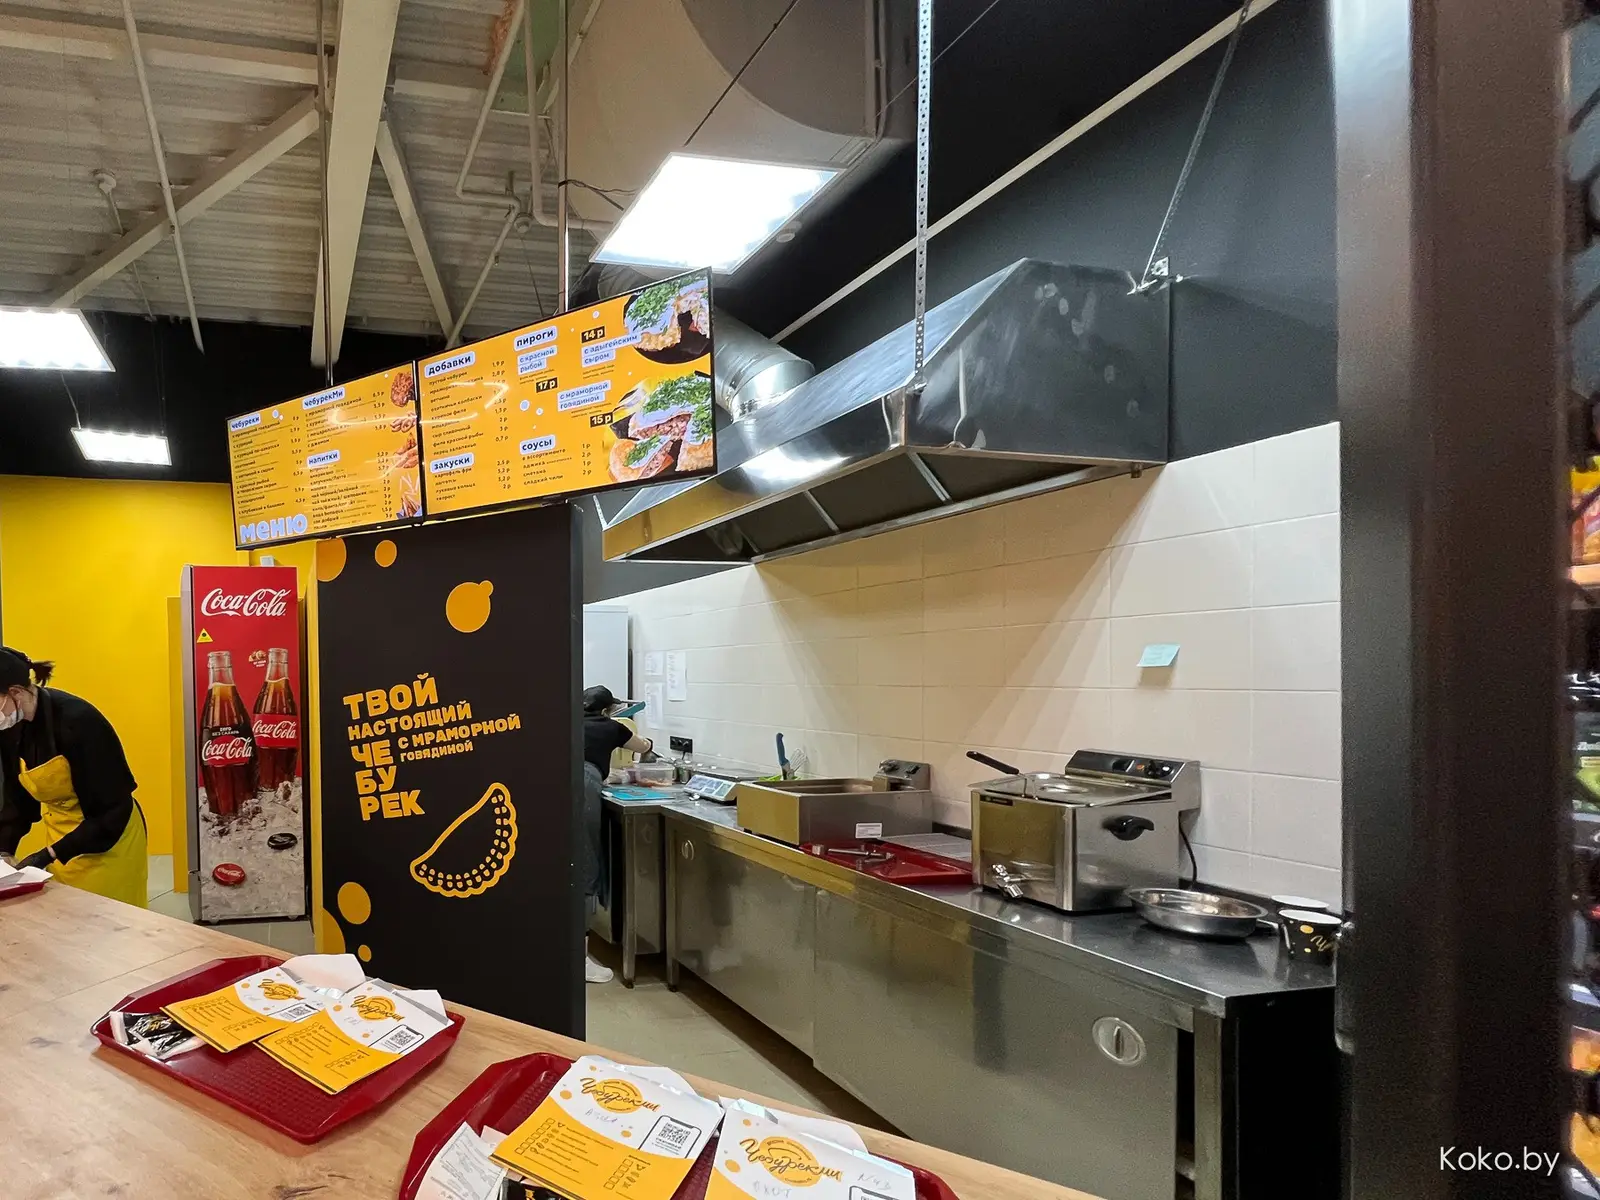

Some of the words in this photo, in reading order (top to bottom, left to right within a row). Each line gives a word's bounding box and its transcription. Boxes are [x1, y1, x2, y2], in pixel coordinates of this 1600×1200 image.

[516, 329, 554, 348] пироги
[583, 331, 596, 340] 14
[597, 329, 604, 338] р
[590, 335, 638, 353] адыгейским
[525, 348, 554, 361] красной
[584, 352, 610, 364] сыром
[428, 356, 471, 376] добавки
[520, 361, 543, 373] рыбой
[538, 381, 548, 390] 17
[550, 380, 556, 388] р
[565, 382, 608, 398] мраморной
[560, 395, 600, 410] говядиной
[232, 416, 260, 430] чебуреки
[591, 415, 604, 425] 15
[605, 414, 612, 423] р
[522, 439, 552, 451] соусы
[309, 453, 338, 465] напитки
[434, 457, 470, 470] закуски
[201, 588, 292, 617] Coca-Cola
[342, 672, 439, 720] ТВОЙ
[347, 700, 473, 741] НАСТОЯЩИЙ
[398, 736, 409, 749] С
[412, 714, 521, 748] МРАМОРНОЙ
[350, 739, 394, 768] ЧЕ
[400, 740, 474, 763] ГОВЯДИНОЙ
[355, 765, 397, 795] БУ
[359, 789, 426, 821] РЕК
